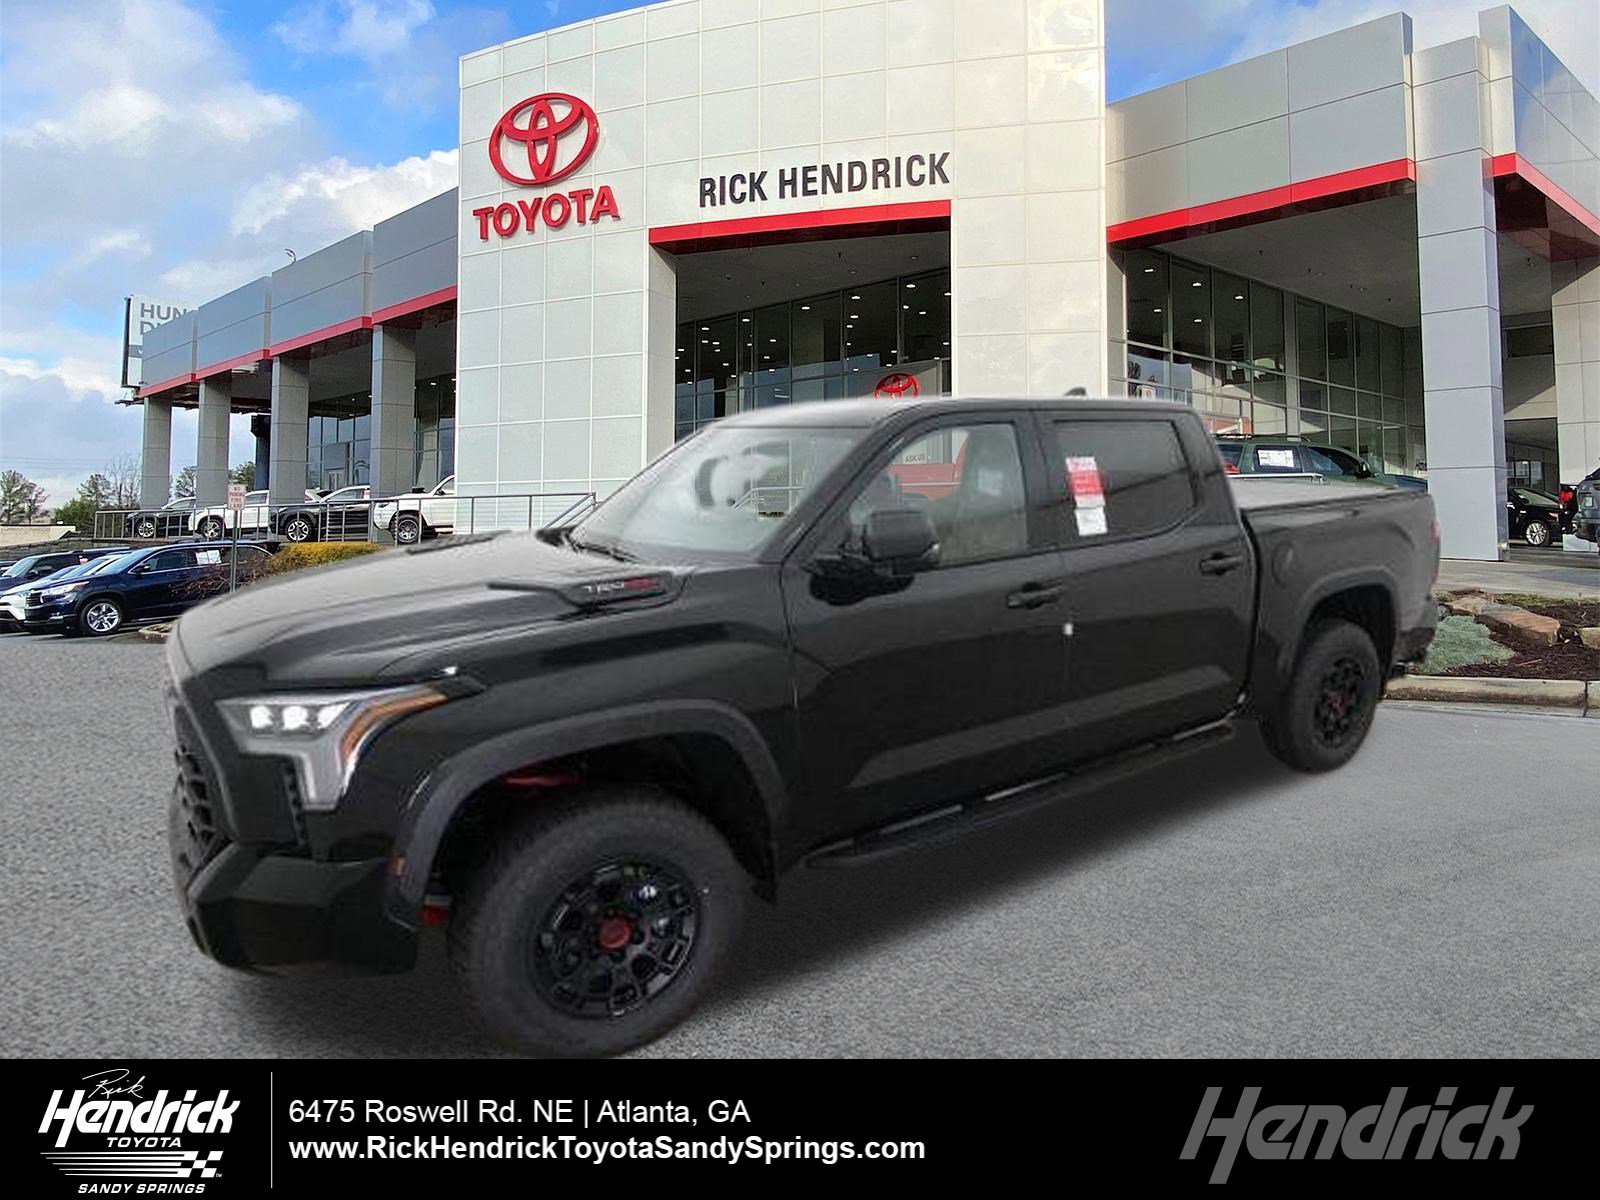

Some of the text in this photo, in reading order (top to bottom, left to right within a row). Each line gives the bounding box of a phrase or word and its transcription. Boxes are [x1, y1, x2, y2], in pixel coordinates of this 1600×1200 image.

[699, 152, 950, 208] RICK HENDRICK
[473, 185, 620, 241] TOYOTA
